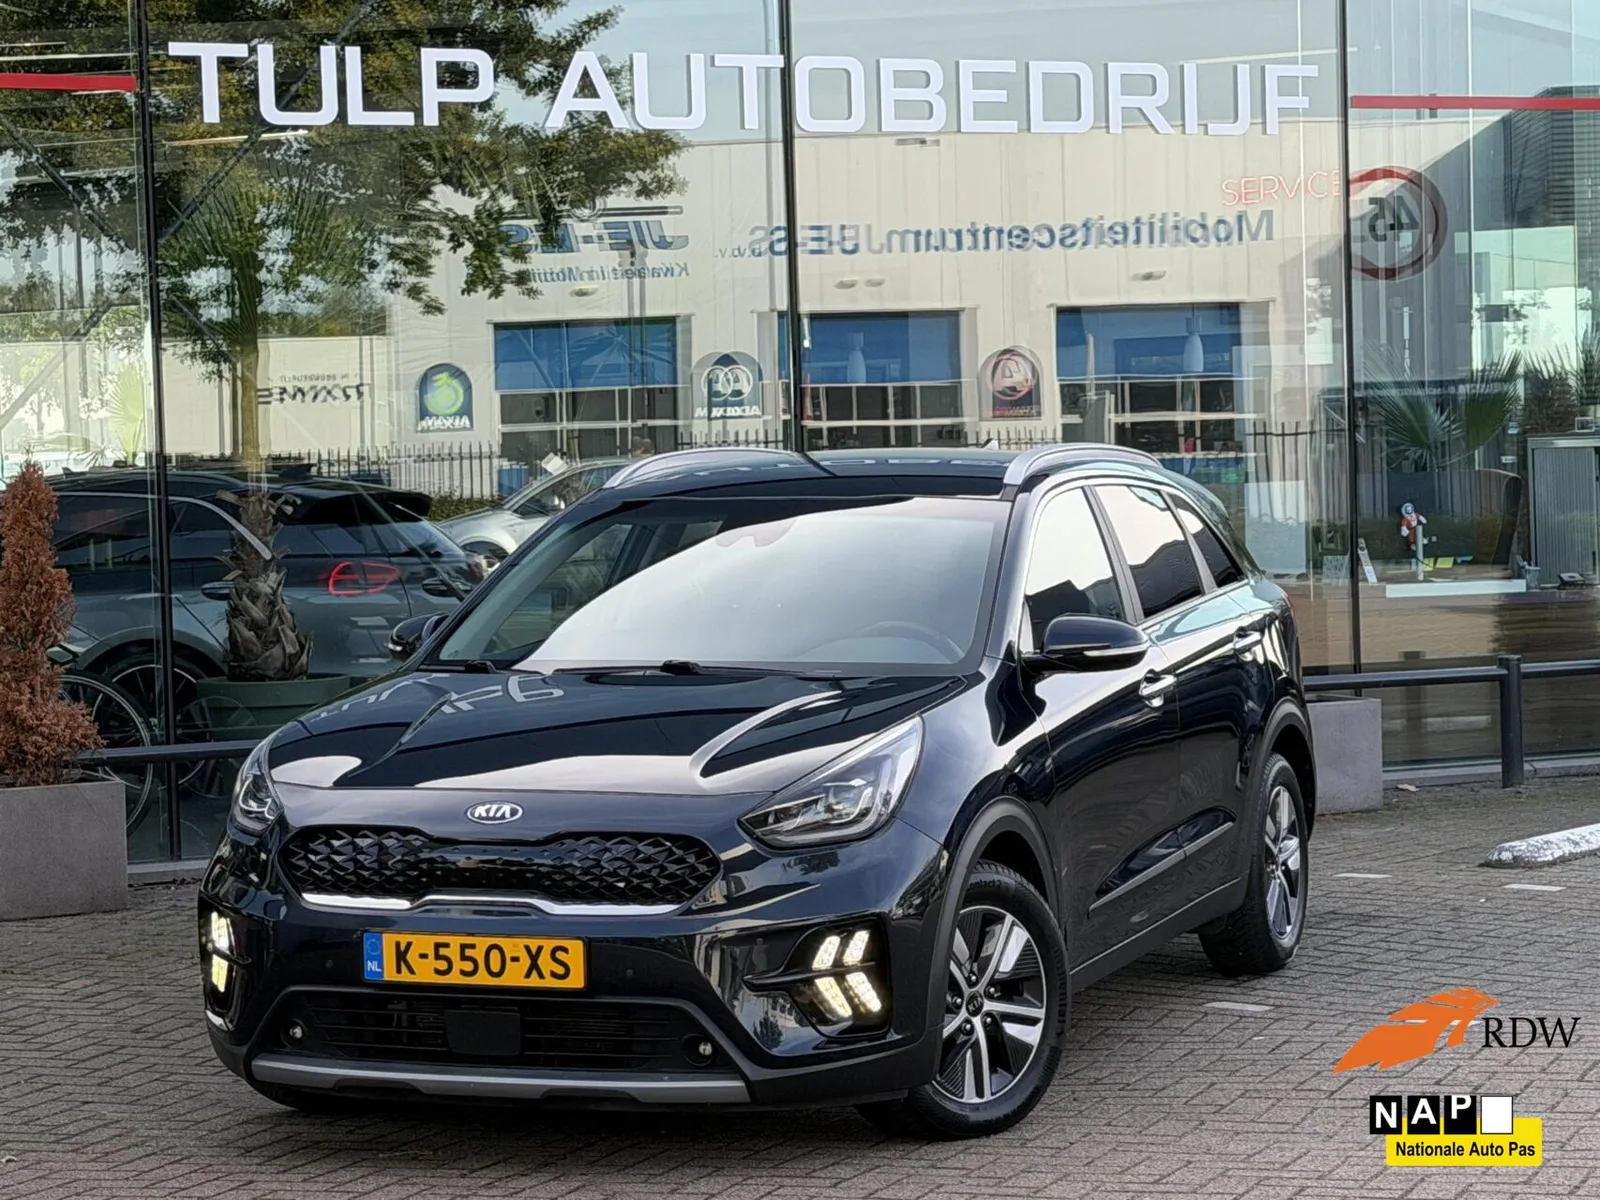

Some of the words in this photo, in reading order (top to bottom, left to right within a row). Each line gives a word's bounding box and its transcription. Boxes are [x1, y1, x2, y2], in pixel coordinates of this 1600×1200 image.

[167, 41, 495, 127] TULP
[545, 51, 1319, 136] AUTOBEDRIJF
[474, 803, 512, 818] KIA
[367, 960, 382, 972] NL
[394, 940, 571, 981] K-550-XS
